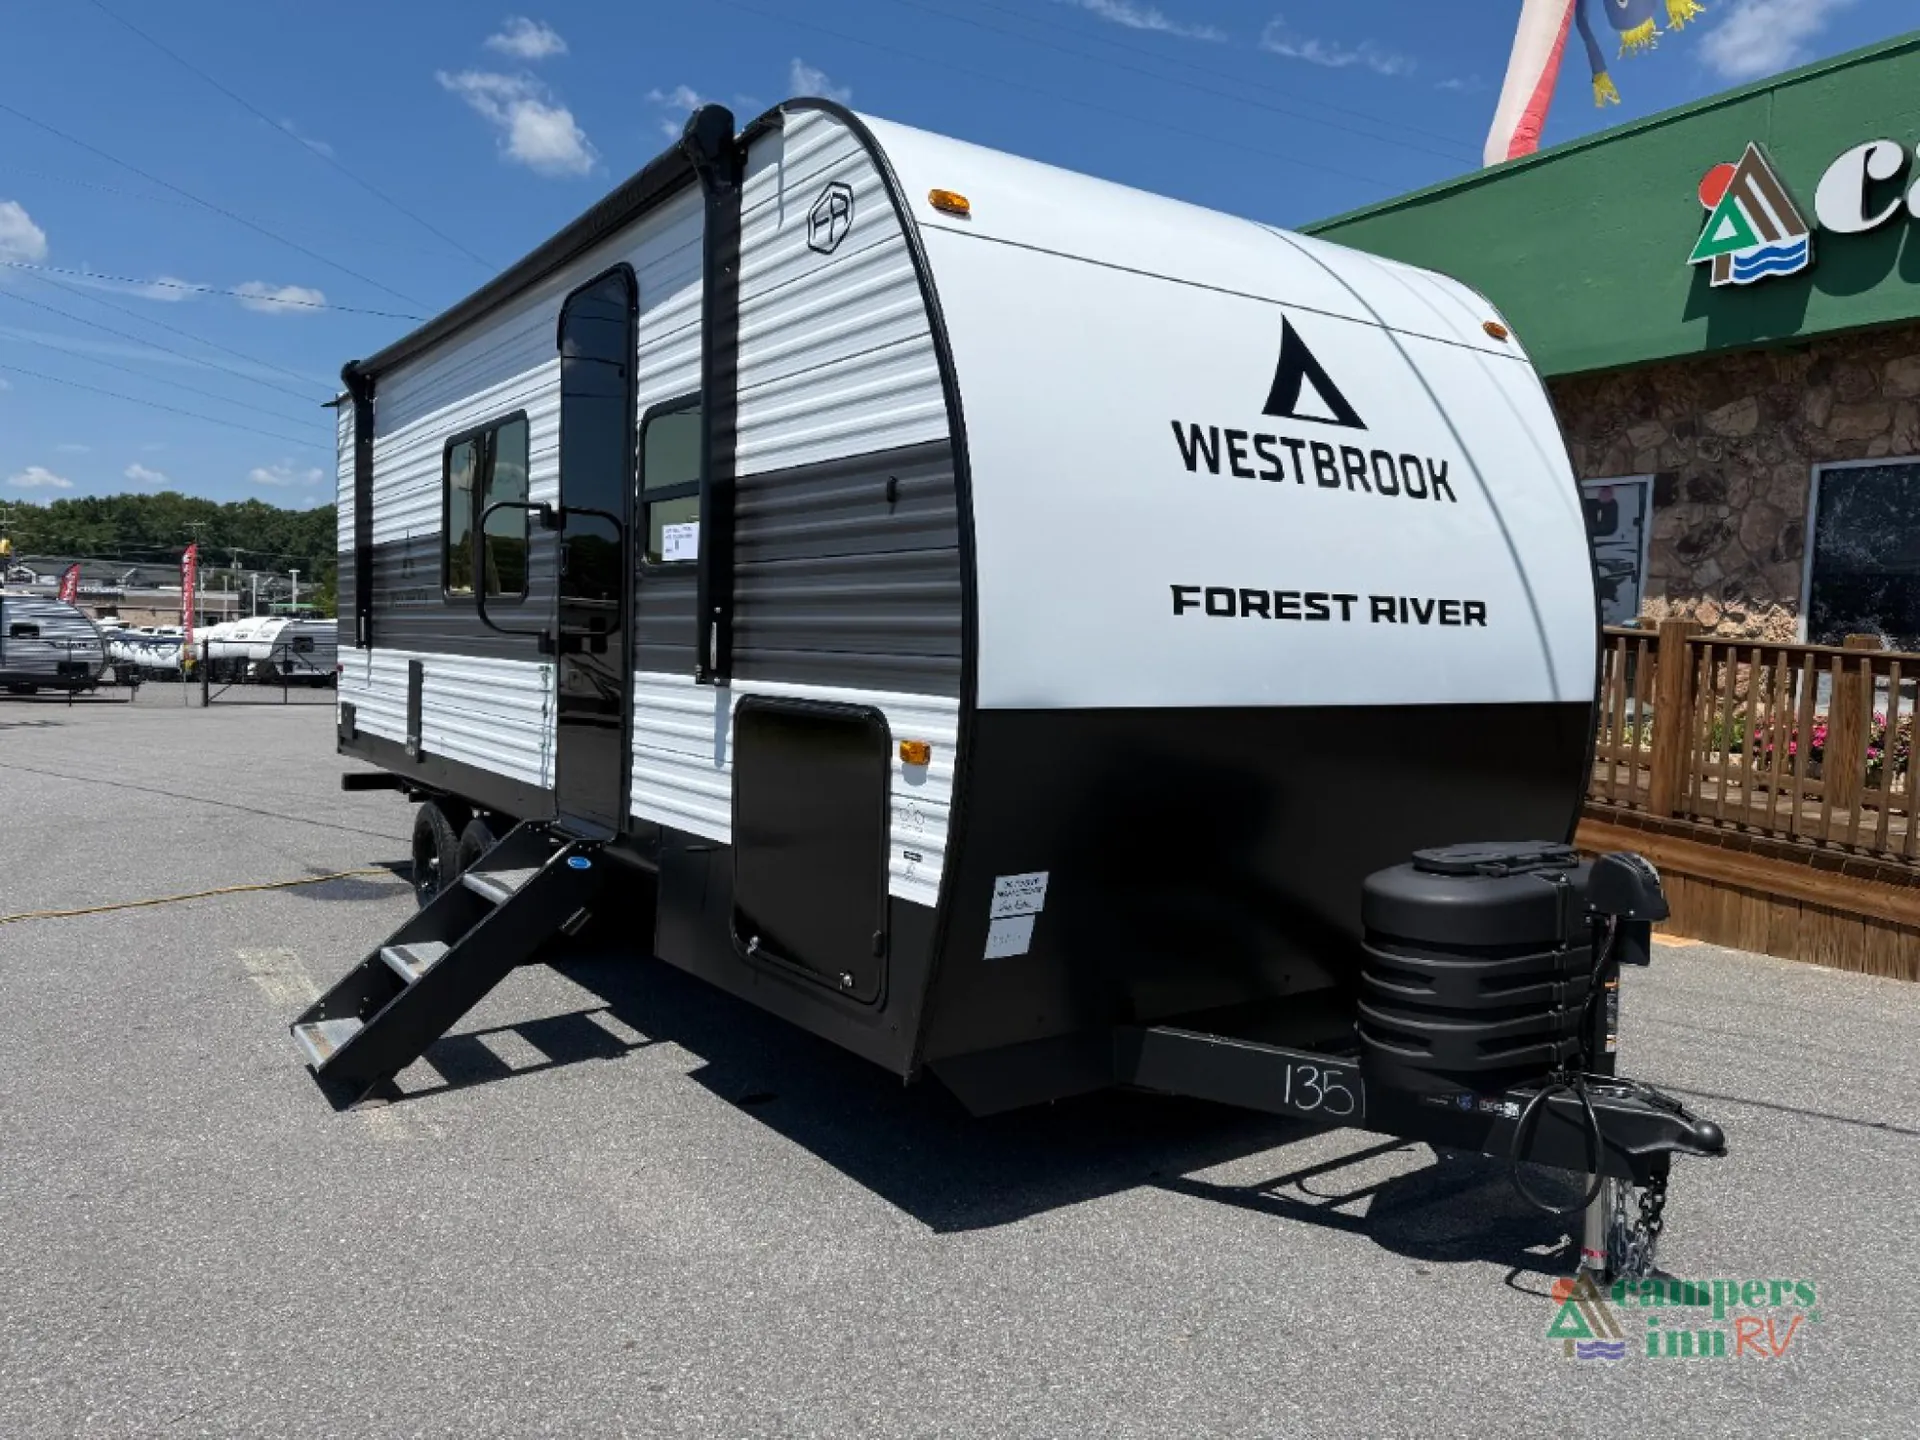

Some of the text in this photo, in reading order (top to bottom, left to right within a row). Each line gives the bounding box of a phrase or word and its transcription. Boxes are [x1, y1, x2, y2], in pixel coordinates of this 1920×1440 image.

[1171, 420, 1457, 502] WESTBROOK
[1170, 584, 1487, 626] FOREST RIVER
[1284, 1063, 1354, 1115] 135
